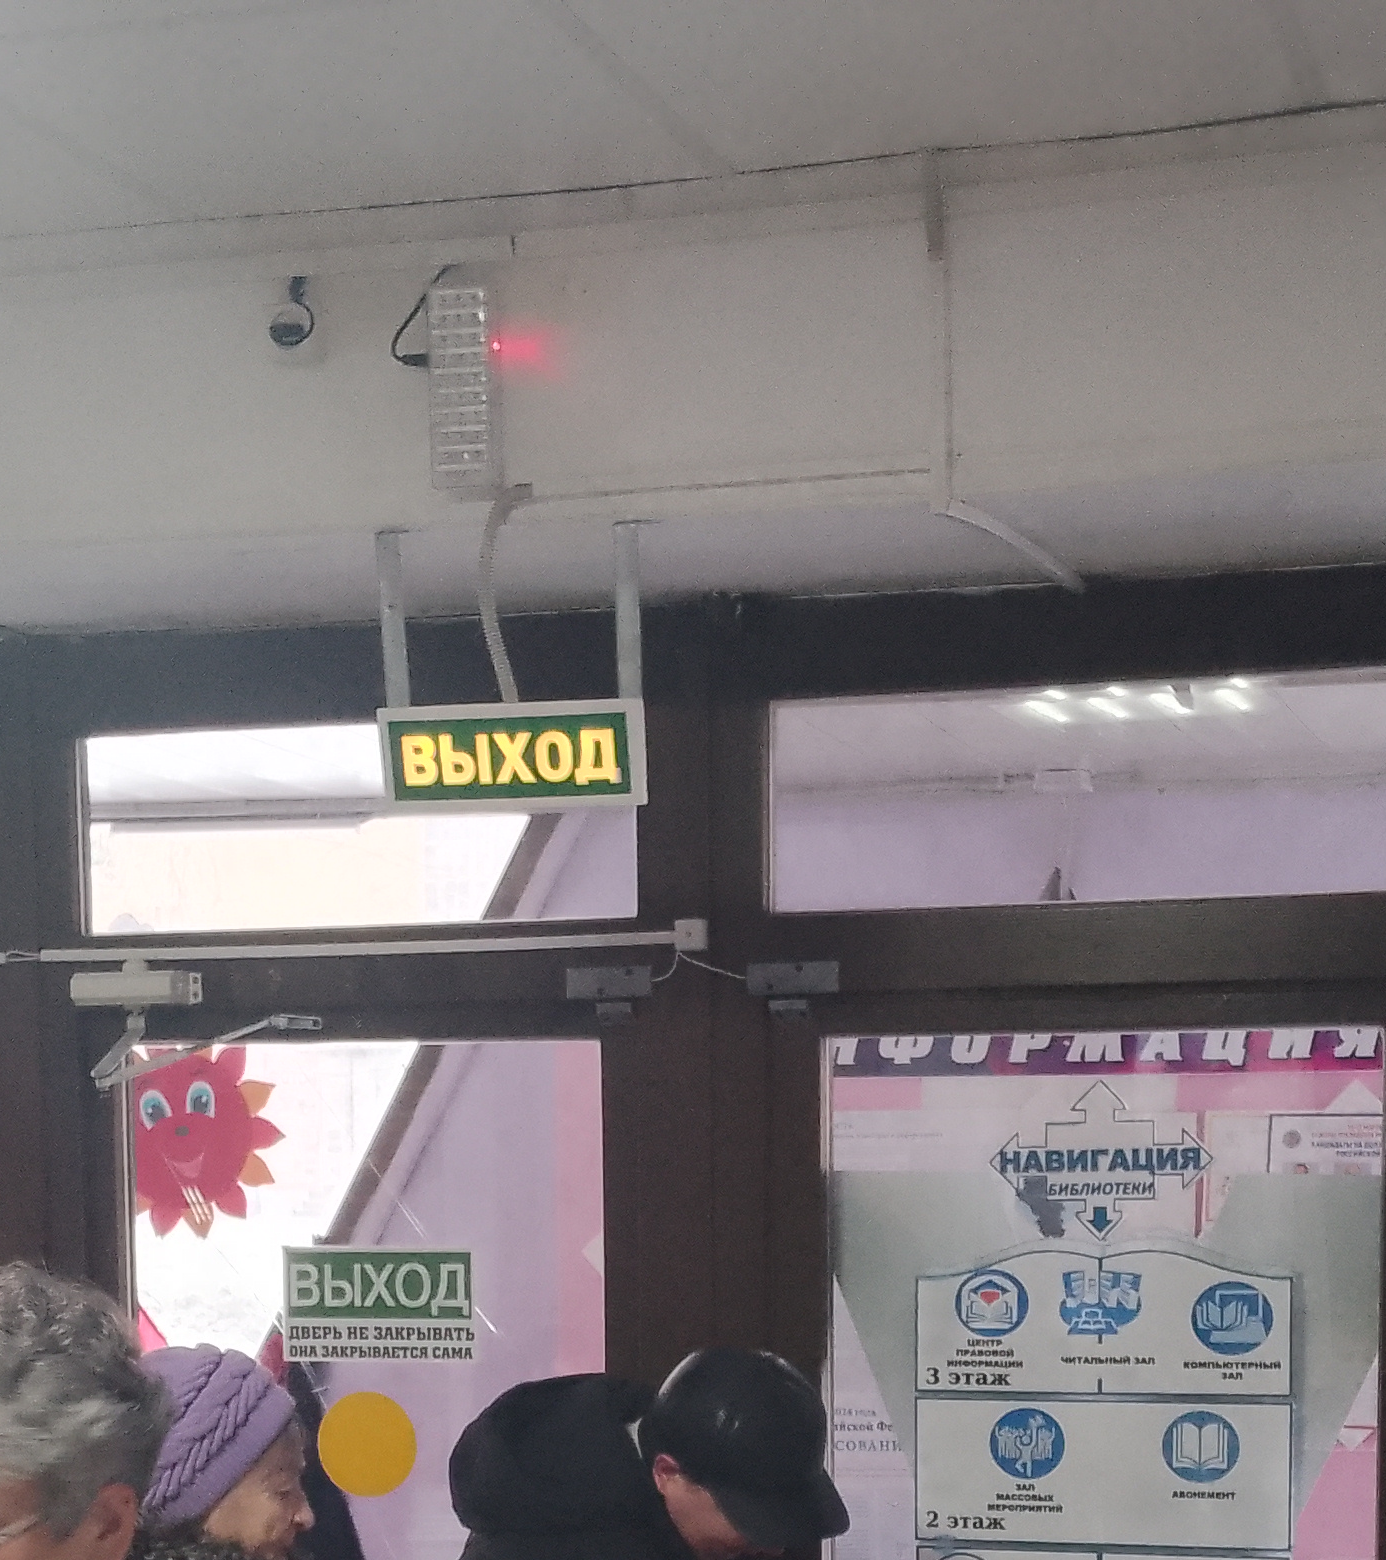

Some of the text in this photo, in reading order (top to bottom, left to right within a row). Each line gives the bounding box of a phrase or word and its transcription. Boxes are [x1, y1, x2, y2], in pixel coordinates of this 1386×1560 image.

[401, 728, 622, 787] ВЫХОД
[1000, 1148, 1201, 1173] НАВИГАЦИЯ
[1049, 1182, 1155, 1197] БИБЛИОТЕКИ
[289, 1262, 470, 1316] ВЫХОД
[289, 1325, 475, 1341] ДВЕРЬ НЕ ЗАКРЫВАТЬ
[966, 1339, 1003, 1348] ЦЕНТР
[289, 1344, 473, 1359] ОНА ЗАКРЫВАЕТСЯ САМА
[956, 1348, 1015, 1357] ПРАВОВОЙ
[947, 1360, 1023, 1369] ИНФОРМАЦИИ
[1061, 1355, 1156, 1366] ЧИТАЛЬНЫЙ ЗАЛ
[1183, 1360, 1282, 1370] КОМПЬЮТЕРНЫЙ
[926, 1367, 1011, 1387] 3 этаж
[1221, 1371, 1243, 1381] ЗАЛ
[1015, 1483, 1035, 1492] ЗАЛ
[996, 1493, 1054, 1502] МАССОВЫХ
[987, 1503, 1063, 1514] МЕРОПРИЯТИЙ
[925, 1510, 1006, 1531] 2 этаж
